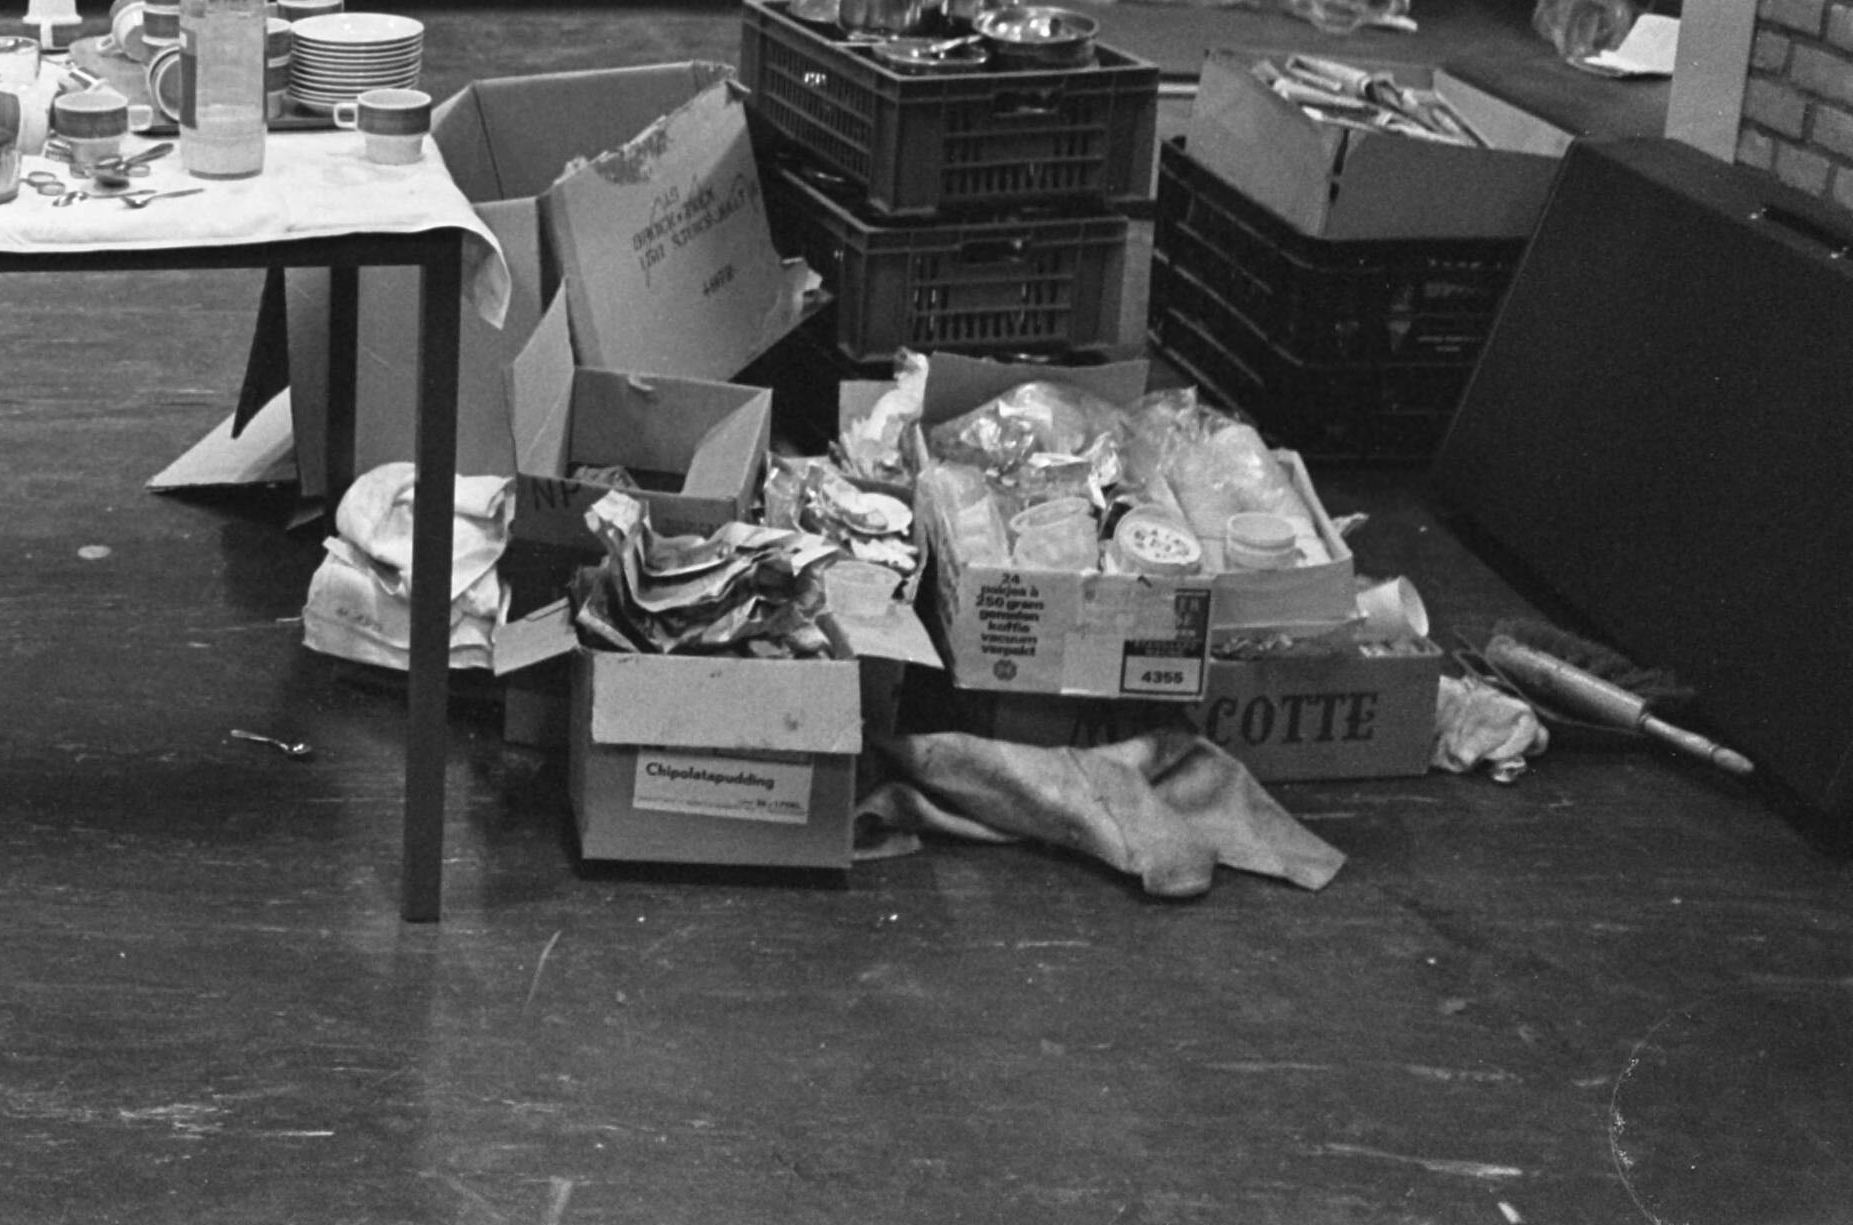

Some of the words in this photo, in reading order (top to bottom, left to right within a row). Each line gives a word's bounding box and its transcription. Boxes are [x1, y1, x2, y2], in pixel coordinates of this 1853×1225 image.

[1001, 573, 1021, 585] 24
[975, 593, 1005, 608] 250
[987, 620, 1030, 633] koffie
[981, 633, 1038, 645] vacuum
[981, 645, 1037, 658] verpakt
[646, 761, 775, 791] Chipolatapudding
